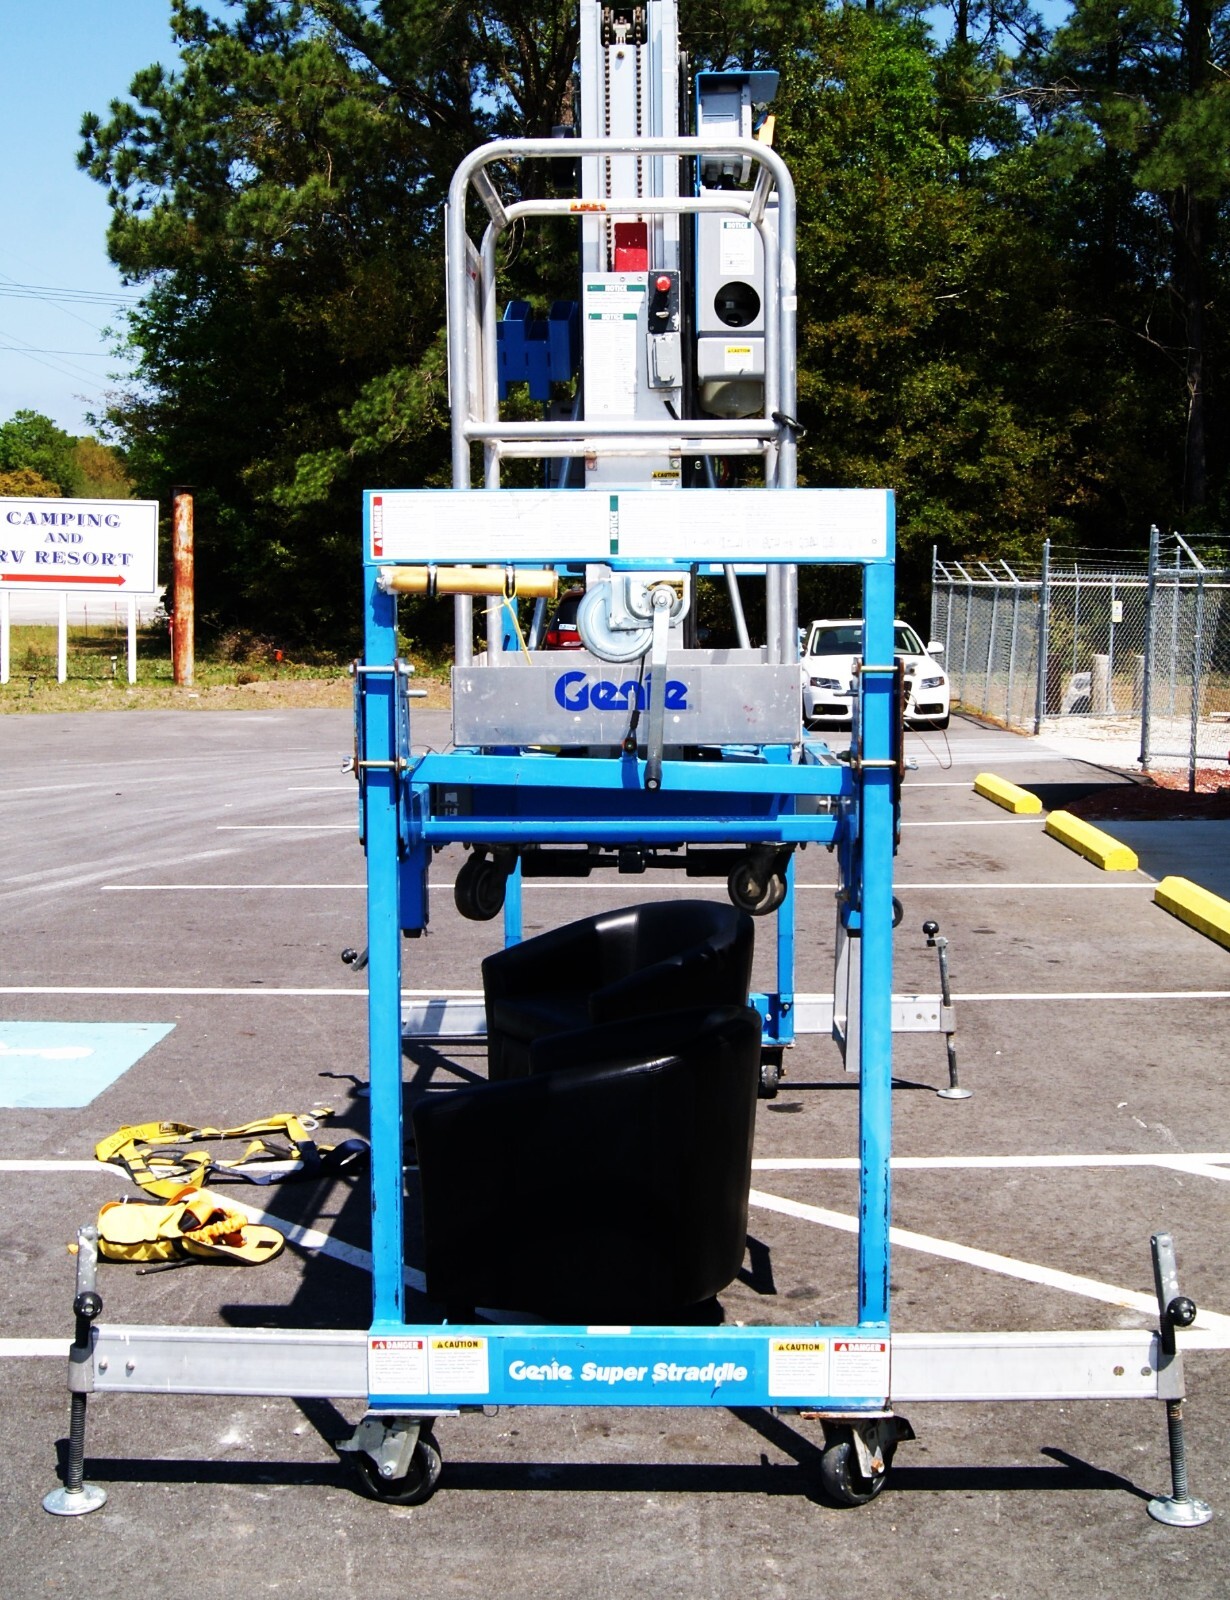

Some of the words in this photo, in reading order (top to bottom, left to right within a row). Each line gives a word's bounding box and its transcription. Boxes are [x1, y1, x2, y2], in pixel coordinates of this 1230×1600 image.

[6, 511, 121, 528] CAMPING
[373, 505, 383, 538] DANGER
[609, 511, 619, 539] NOTICE
[44, 532, 84, 544] AND
[35, 551, 133, 567] RESORT
[386, 1341, 419, 1350] DANGER
[785, 1343, 820, 1351] CAUTION
[848, 1343, 882, 1352] DANGER
[508, 1359, 574, 1381] Genie
[580, 1362, 648, 1385] Super
[652, 1362, 748, 1383] Straddle
